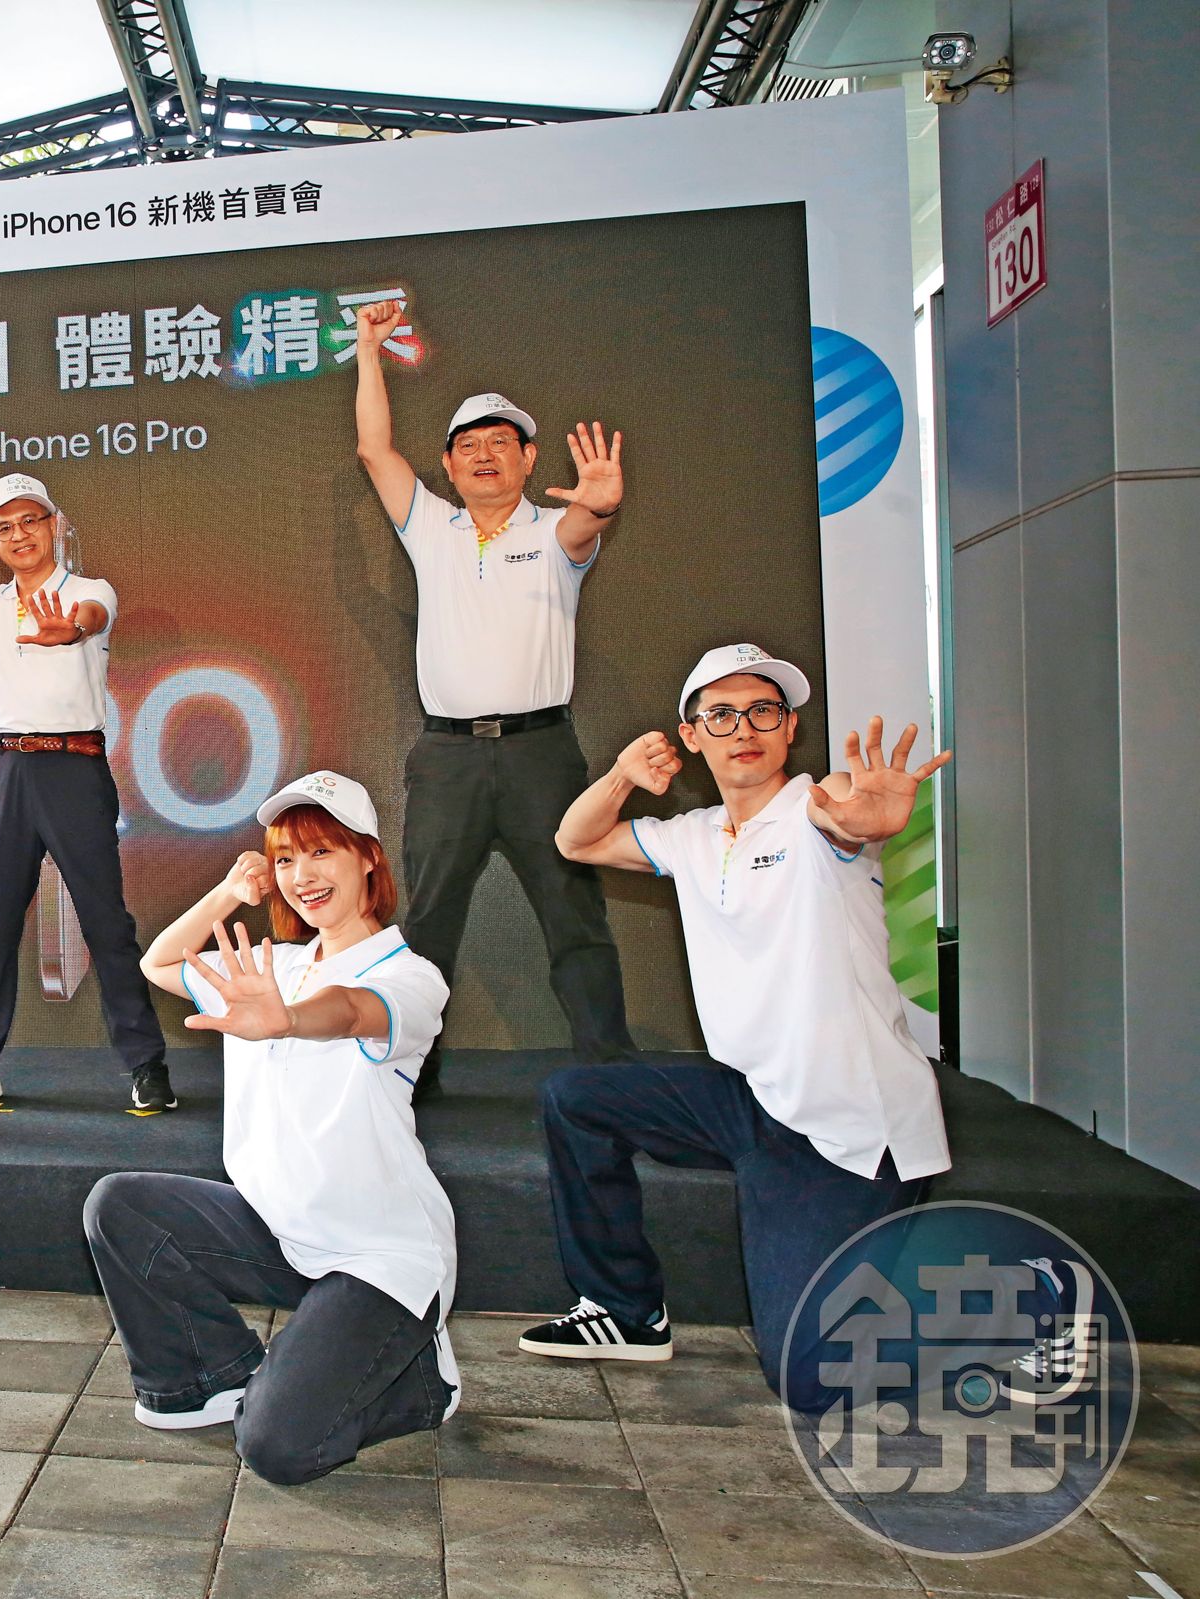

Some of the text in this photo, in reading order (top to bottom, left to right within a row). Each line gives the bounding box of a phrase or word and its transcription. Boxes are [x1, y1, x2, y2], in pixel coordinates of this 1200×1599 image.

[2, 181, 324, 239] iPhone 16 新機首賣會
[995, 226, 1033, 305] 130
[96, 424, 137, 456] 16
[145, 419, 208, 452] Pro
[7, 477, 31, 485] ESG
